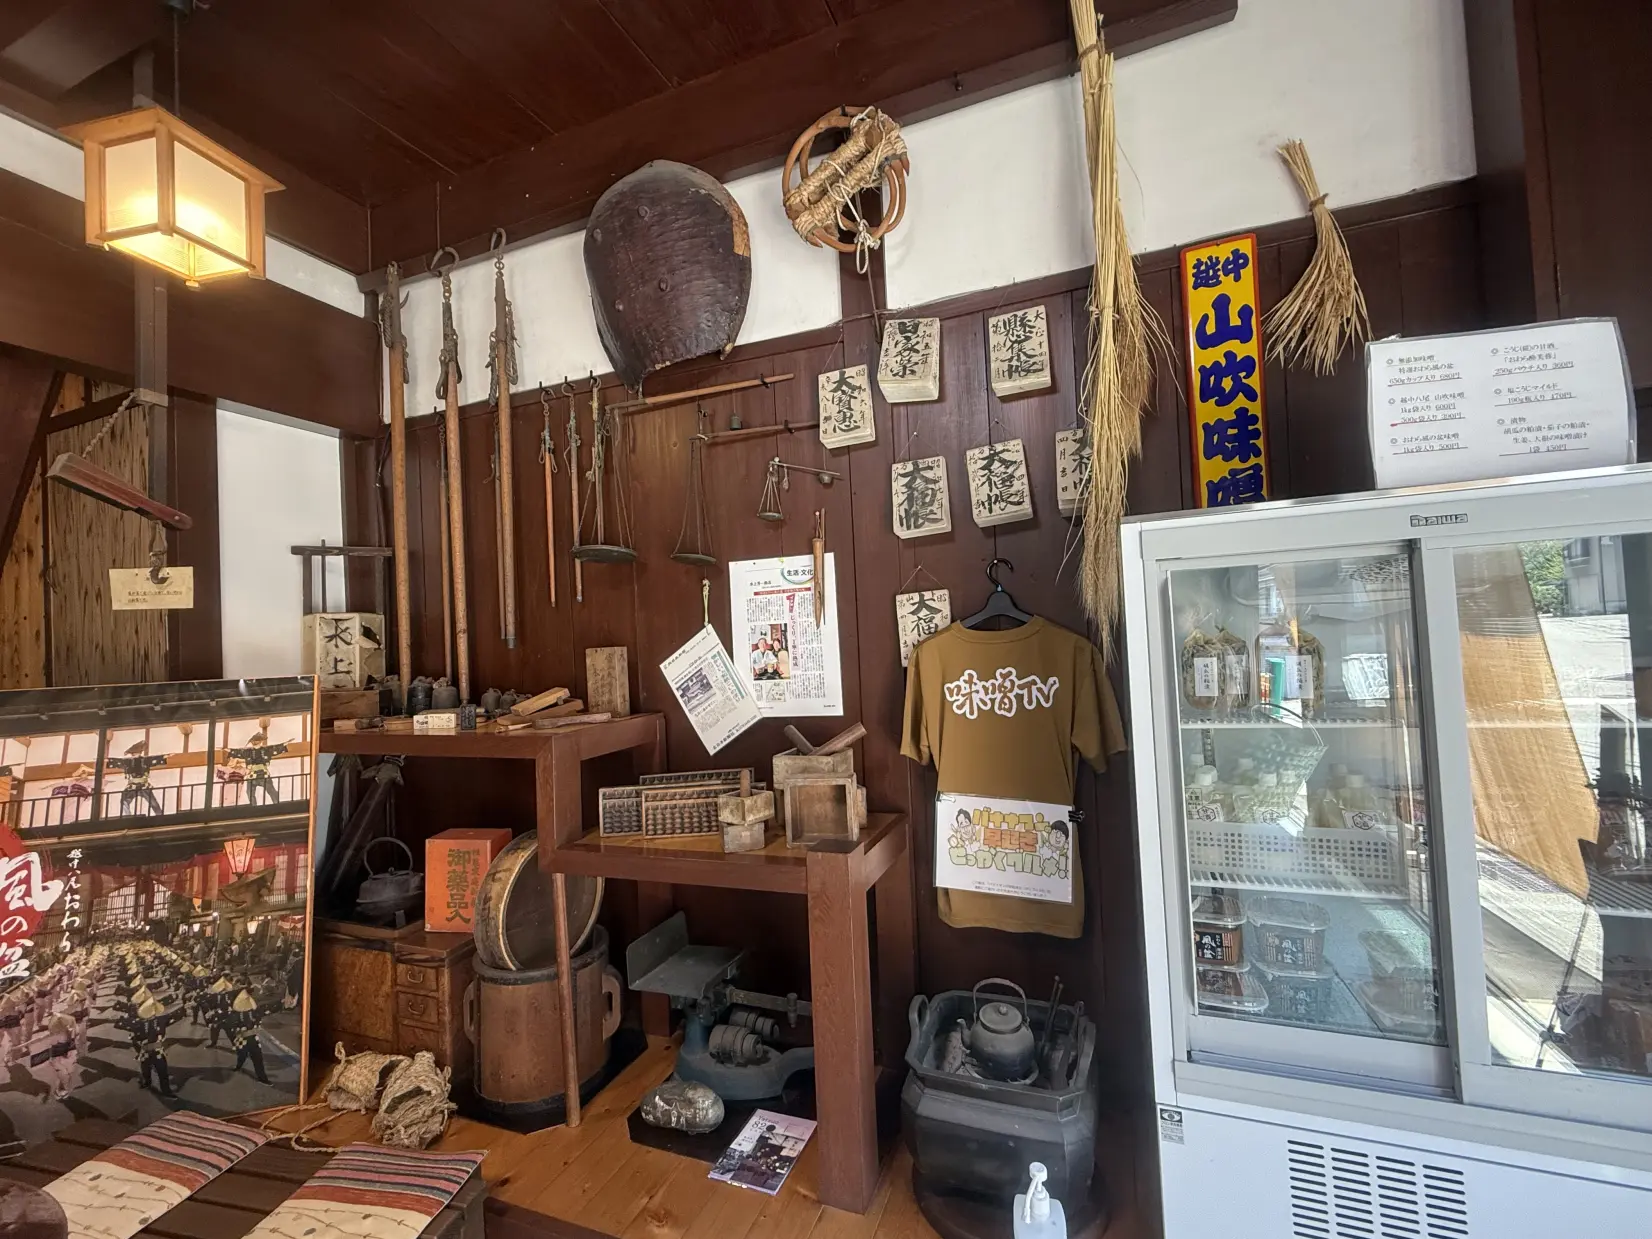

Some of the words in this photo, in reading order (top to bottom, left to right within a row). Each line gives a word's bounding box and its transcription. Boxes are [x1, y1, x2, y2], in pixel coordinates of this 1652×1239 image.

[1192, 249, 1250, 290] 越中
[1195, 293, 1265, 509] 山吹味噌
[944, 666, 1059, 719] 味噌TV
